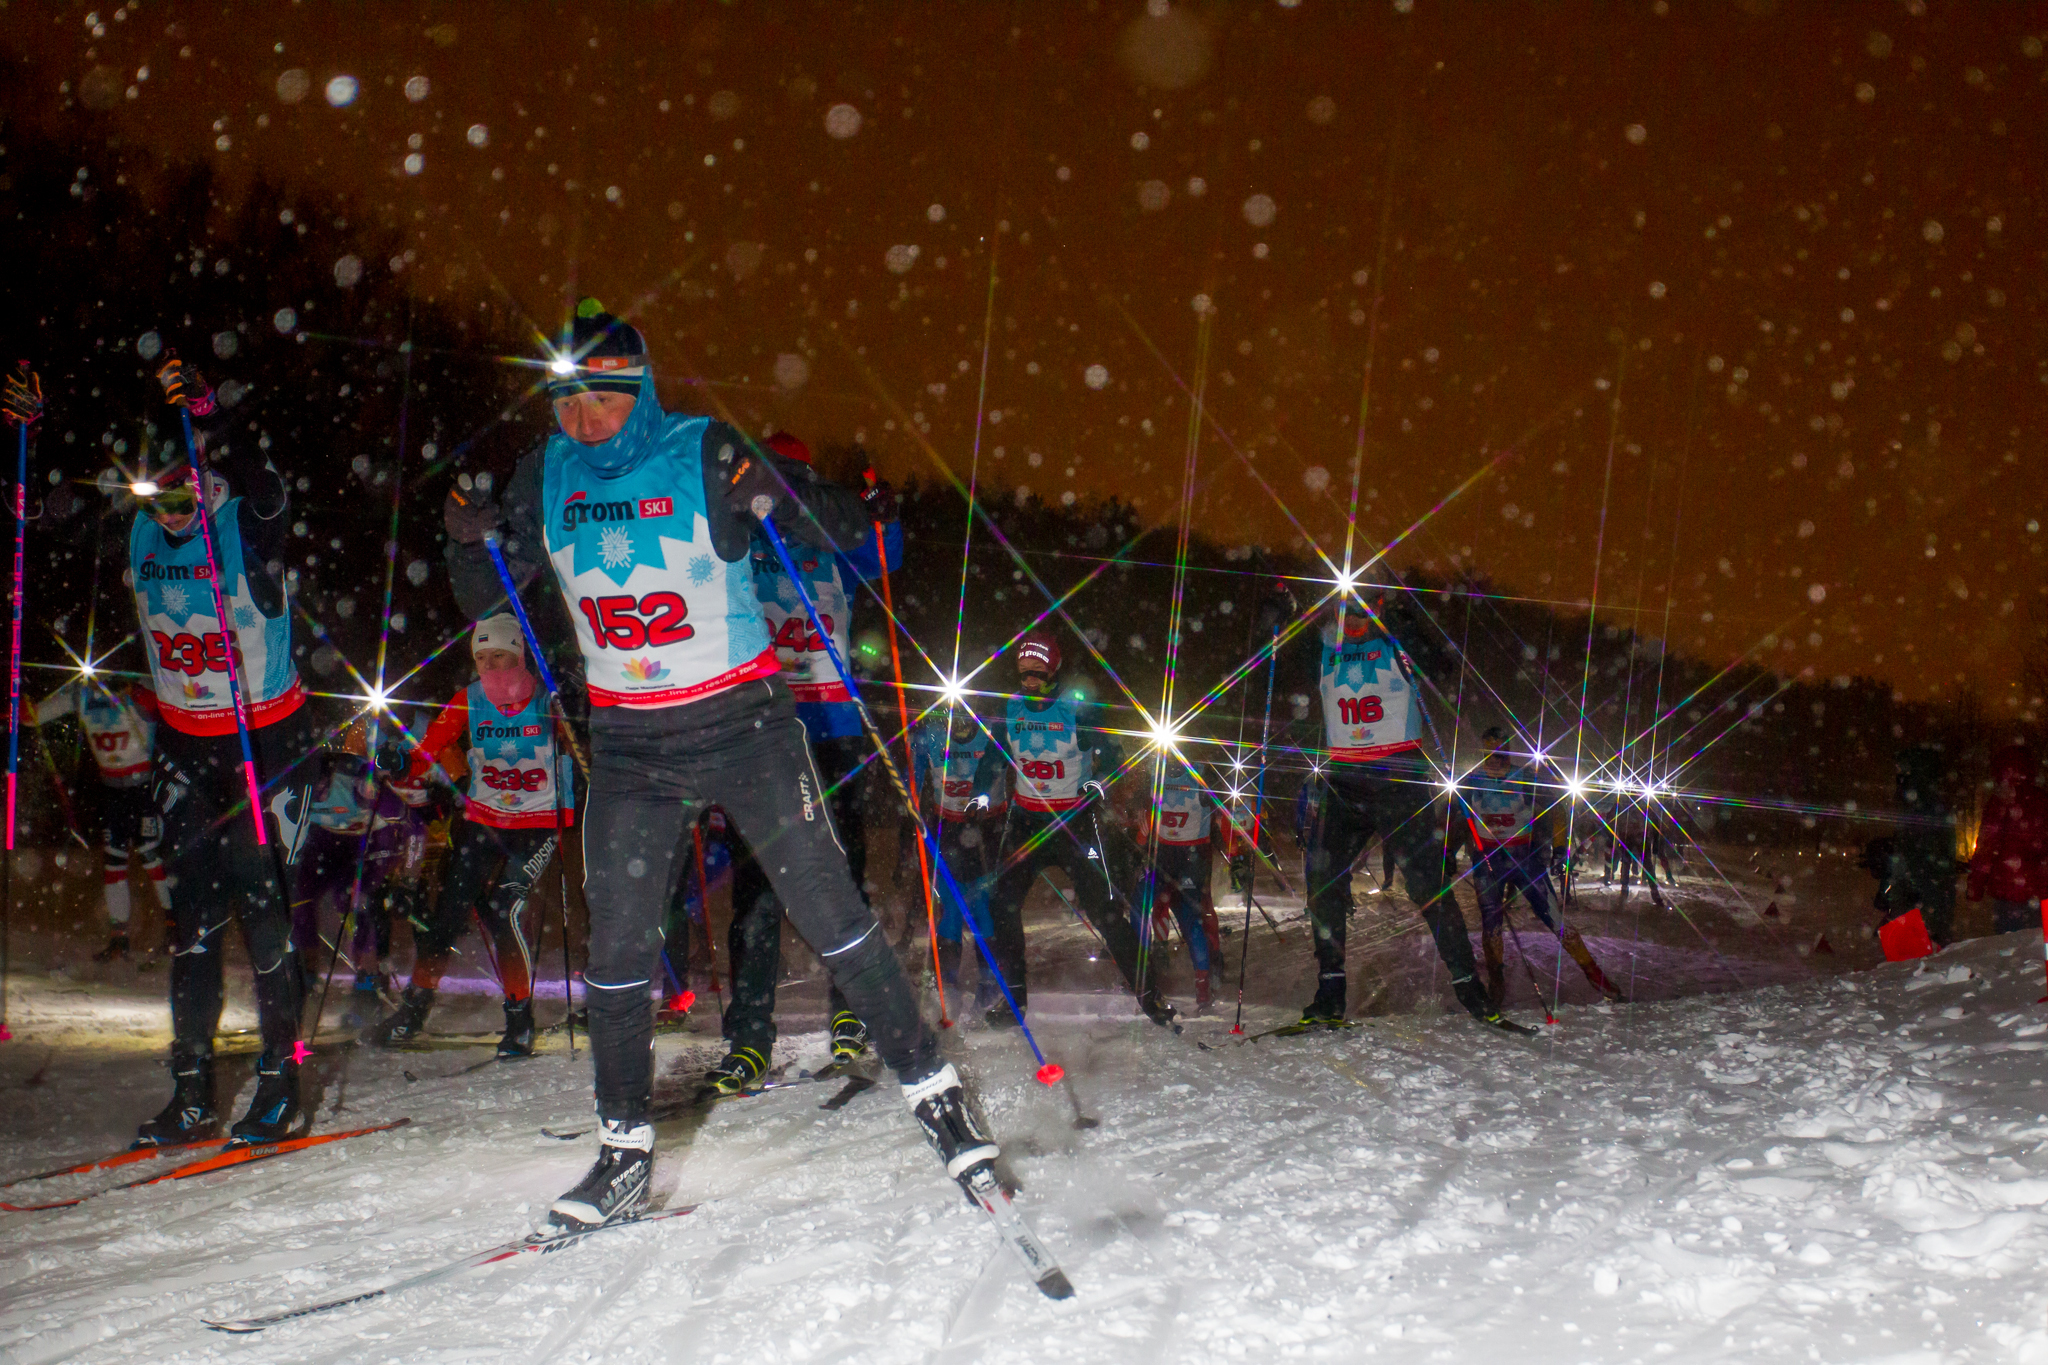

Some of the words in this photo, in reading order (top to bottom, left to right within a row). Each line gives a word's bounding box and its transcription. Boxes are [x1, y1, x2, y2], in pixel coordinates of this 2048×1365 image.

[563, 497, 635, 531] grom
[643, 501, 668, 517] SKI
[140, 560, 190, 581] grom
[579, 591, 695, 650] 152
[151, 631, 244, 677] 235
[1329, 652, 1365, 667] gom
[198, 711, 225, 720] on-line
[1338, 695, 1383, 725] 116
[476, 723, 522, 741] grom
[526, 727, 539, 735] SKI
[1015, 717, 1047, 734] grom
[481, 765, 548, 792] 239
[1020, 757, 1065, 780] 261
[800, 781, 815, 821] CRAFT
[522, 836, 557, 879] CORSAC
[249, 1145, 279, 1158] YOKO
[606, 1136, 645, 1144] MADSHU
[610, 1160, 643, 1188] SUPER
